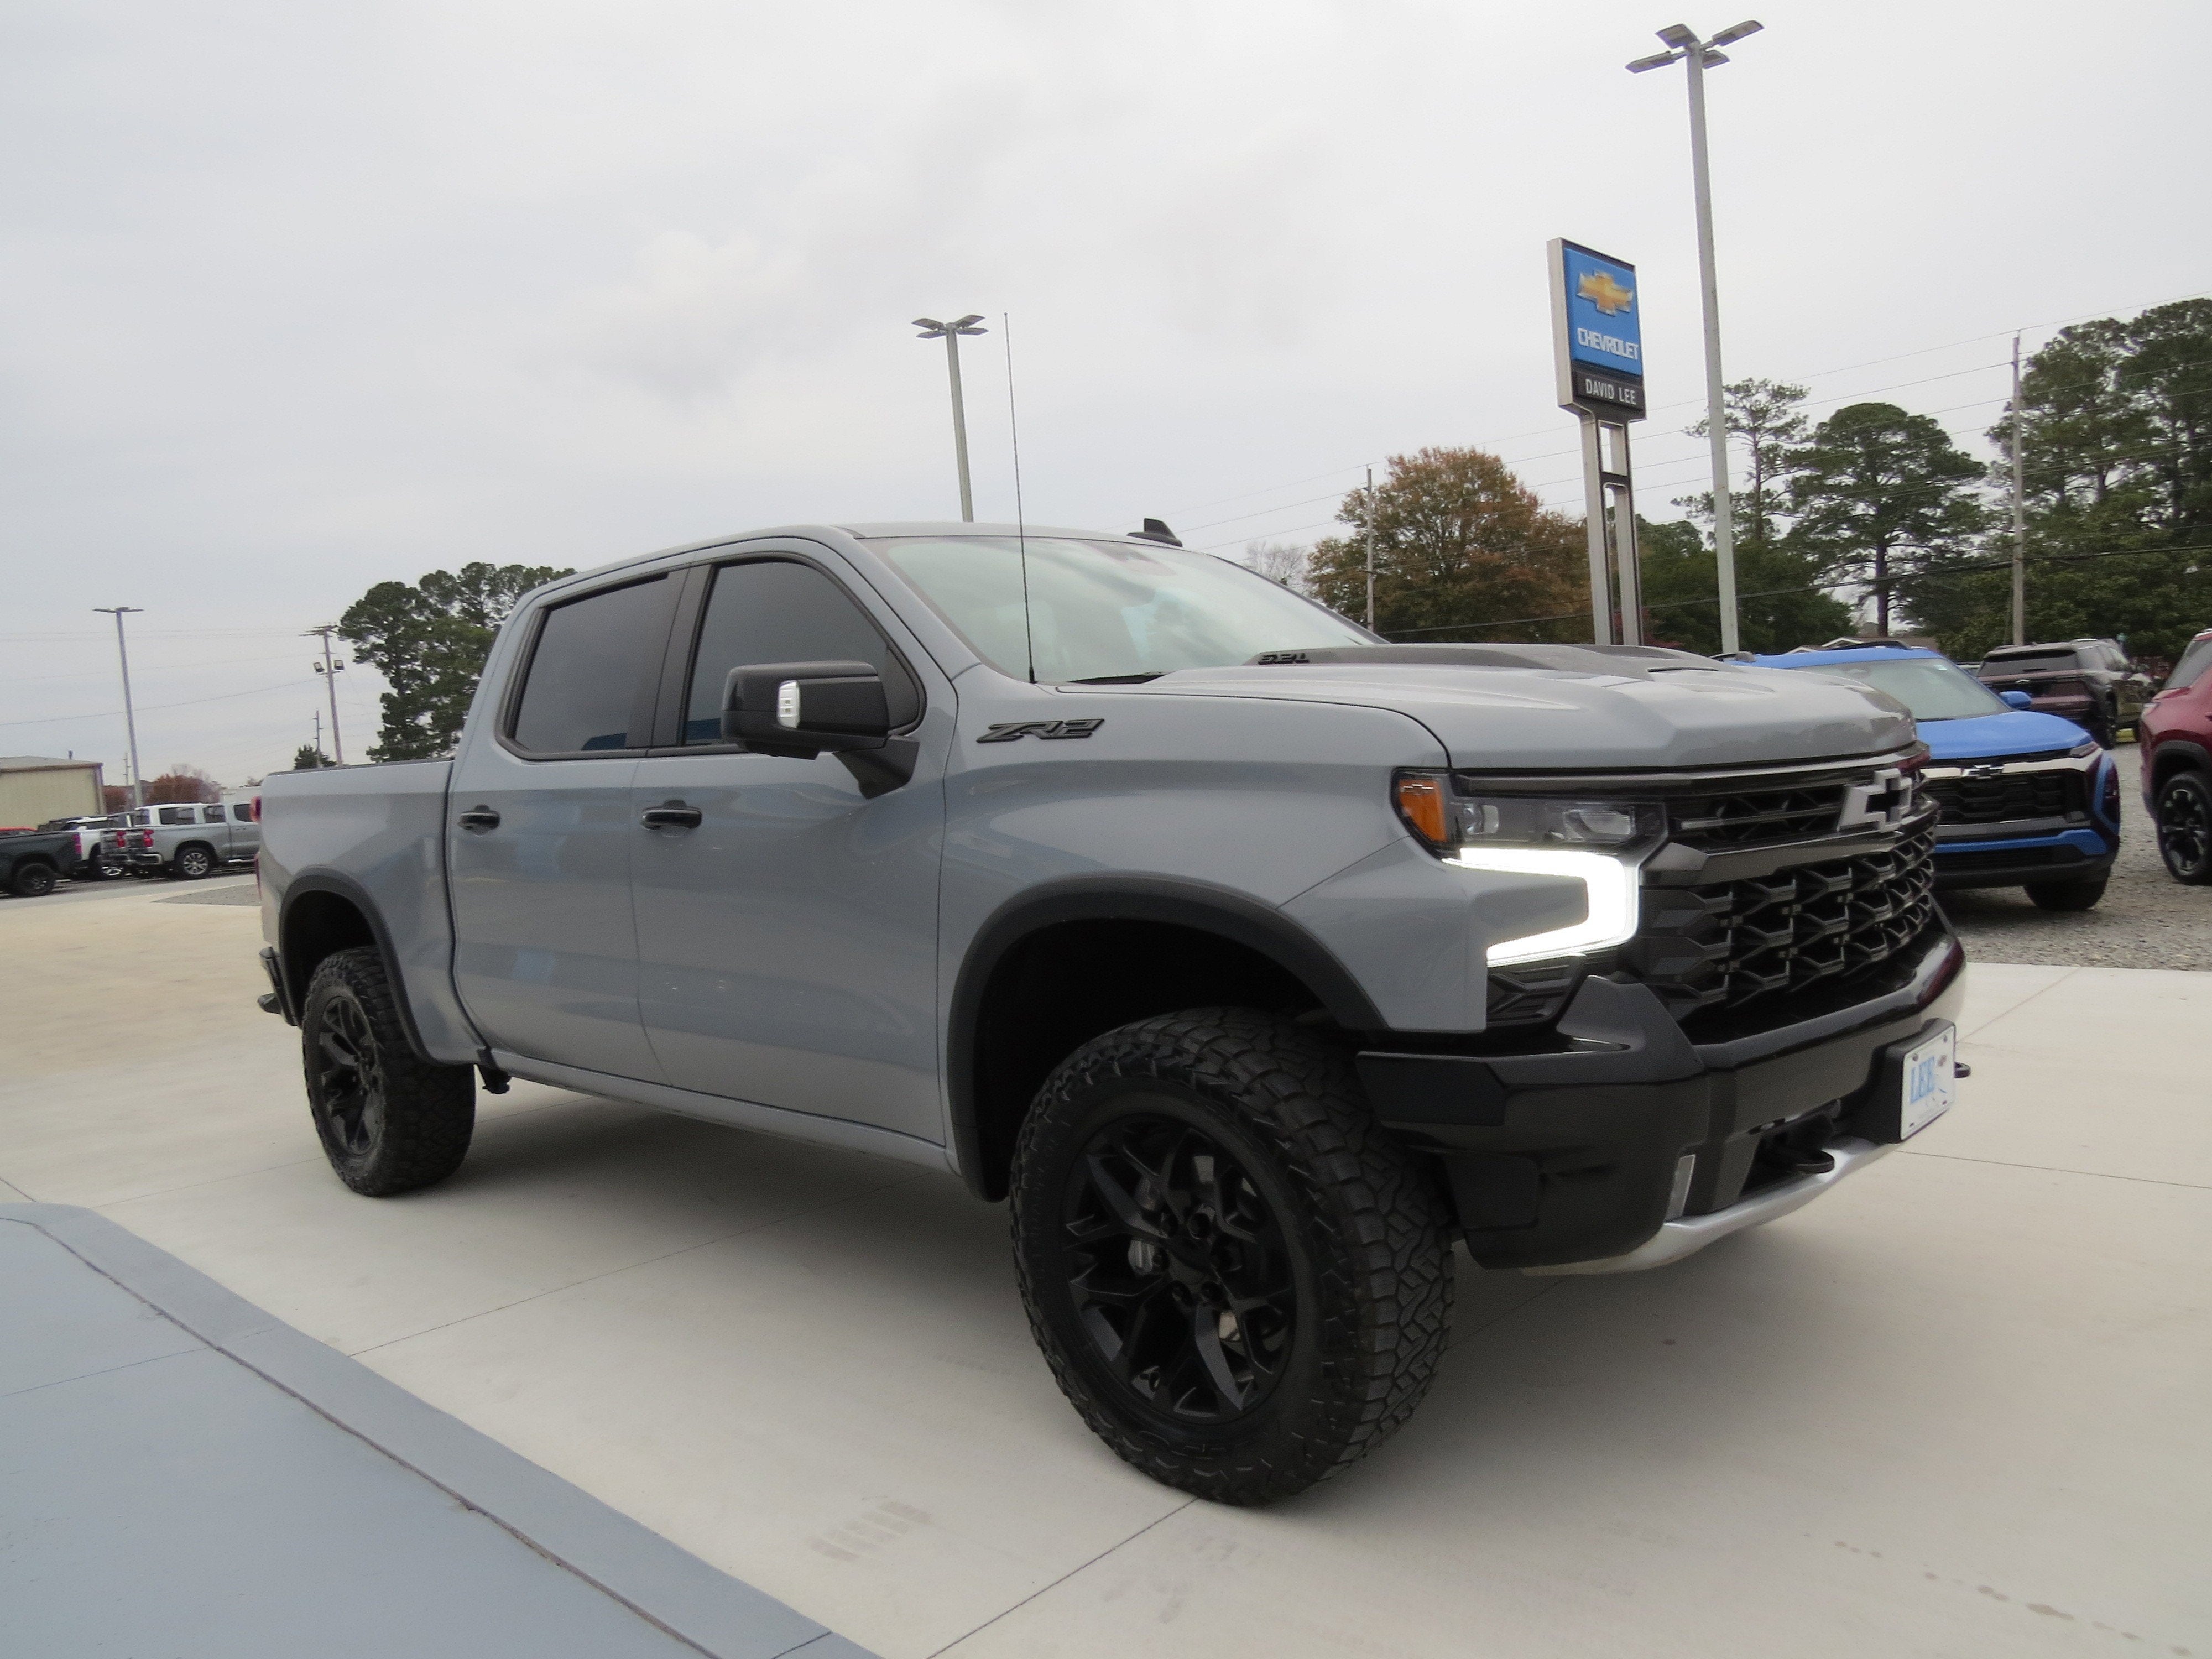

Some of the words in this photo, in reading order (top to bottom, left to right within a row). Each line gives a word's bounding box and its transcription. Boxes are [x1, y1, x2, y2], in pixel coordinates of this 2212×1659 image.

[1578, 328, 1639, 359] CHEVROLET
[1585, 378, 1614, 399] DAVID
[1619, 388, 1636, 405] LEE
[976, 718, 1105, 743] ZR2
